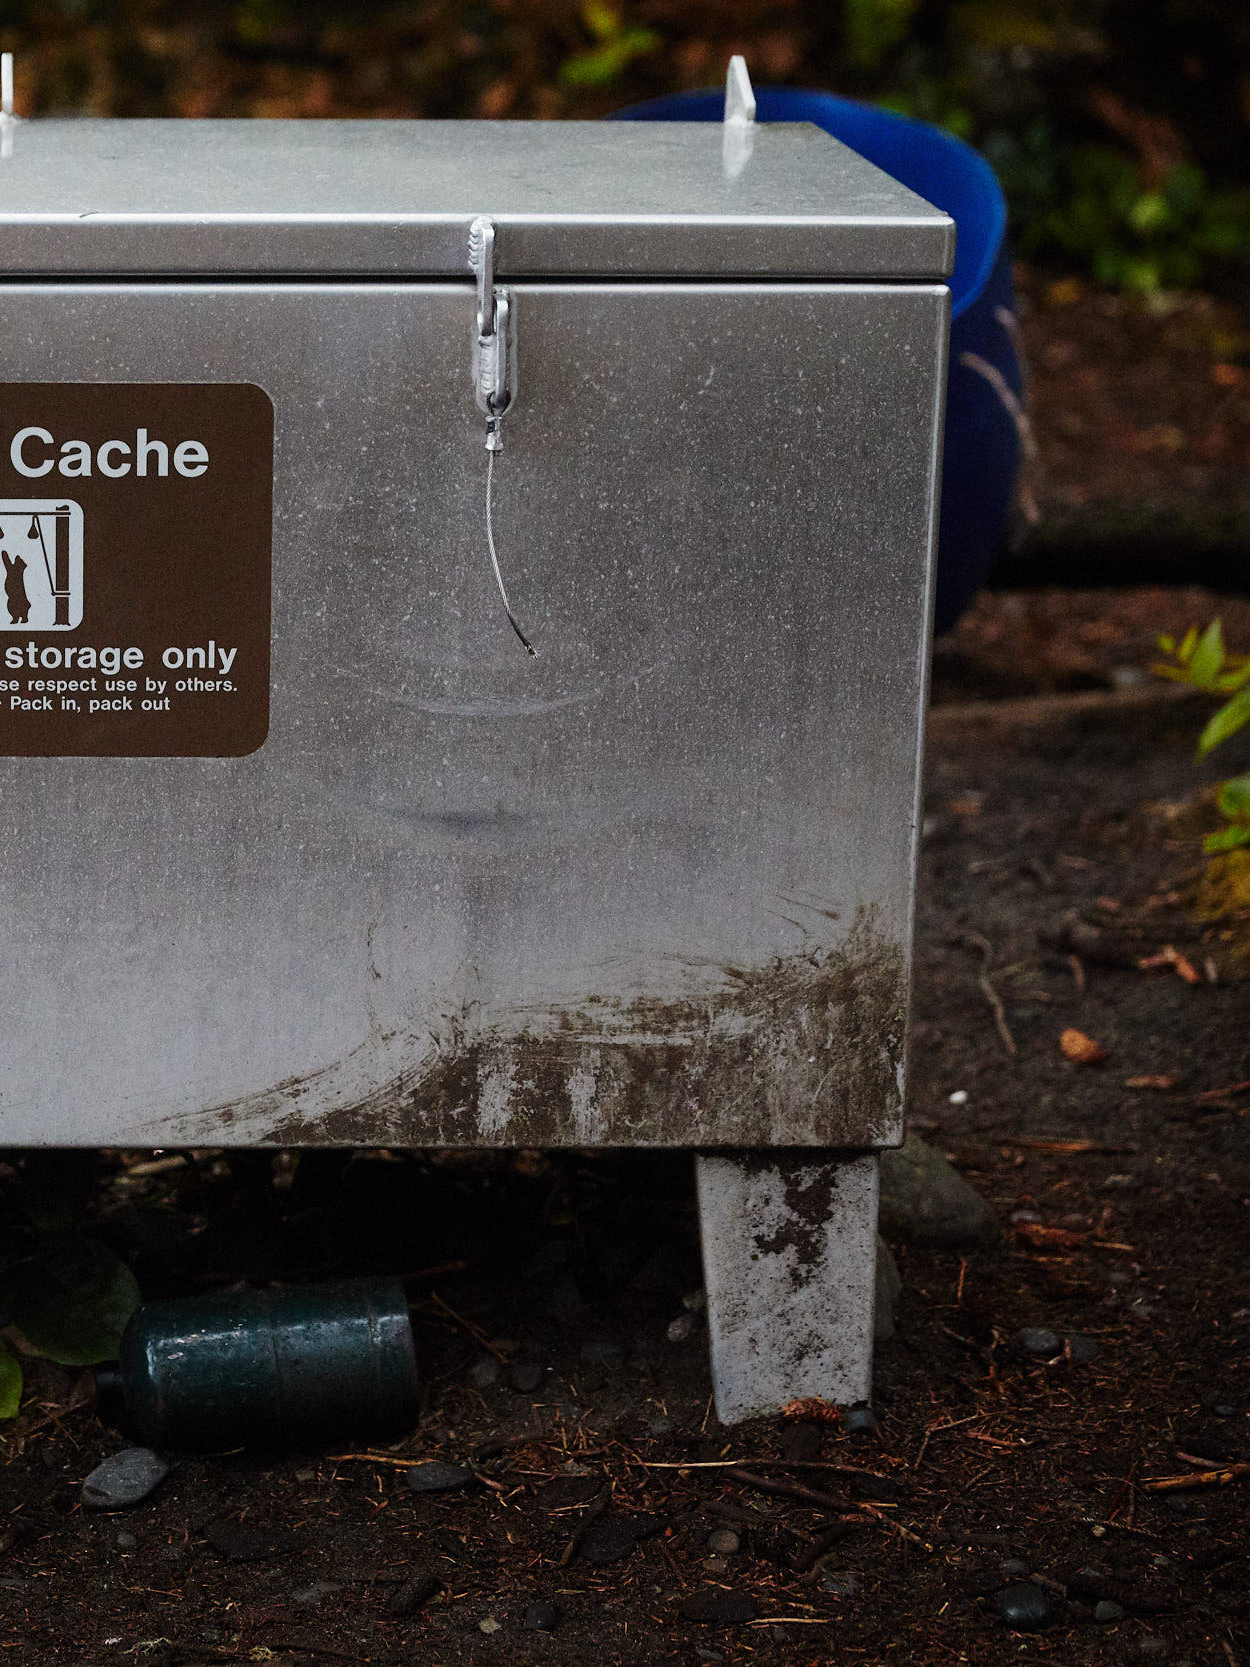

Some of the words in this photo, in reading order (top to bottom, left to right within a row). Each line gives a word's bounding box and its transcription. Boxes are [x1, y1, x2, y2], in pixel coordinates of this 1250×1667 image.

[10, 426, 210, 478] Cache
[4, 642, 144, 675] storage
[161, 640, 238, 675] only
[27, 678, 98, 695] respect
[105, 680, 138, 691] use
[145, 676, 167, 695] by
[175, 677, 238, 691] others.
[9, 695, 53, 711] Pack
[60, 696, 81, 713] in,
[89, 696, 133, 714] pack
[141, 697, 171, 711] out
